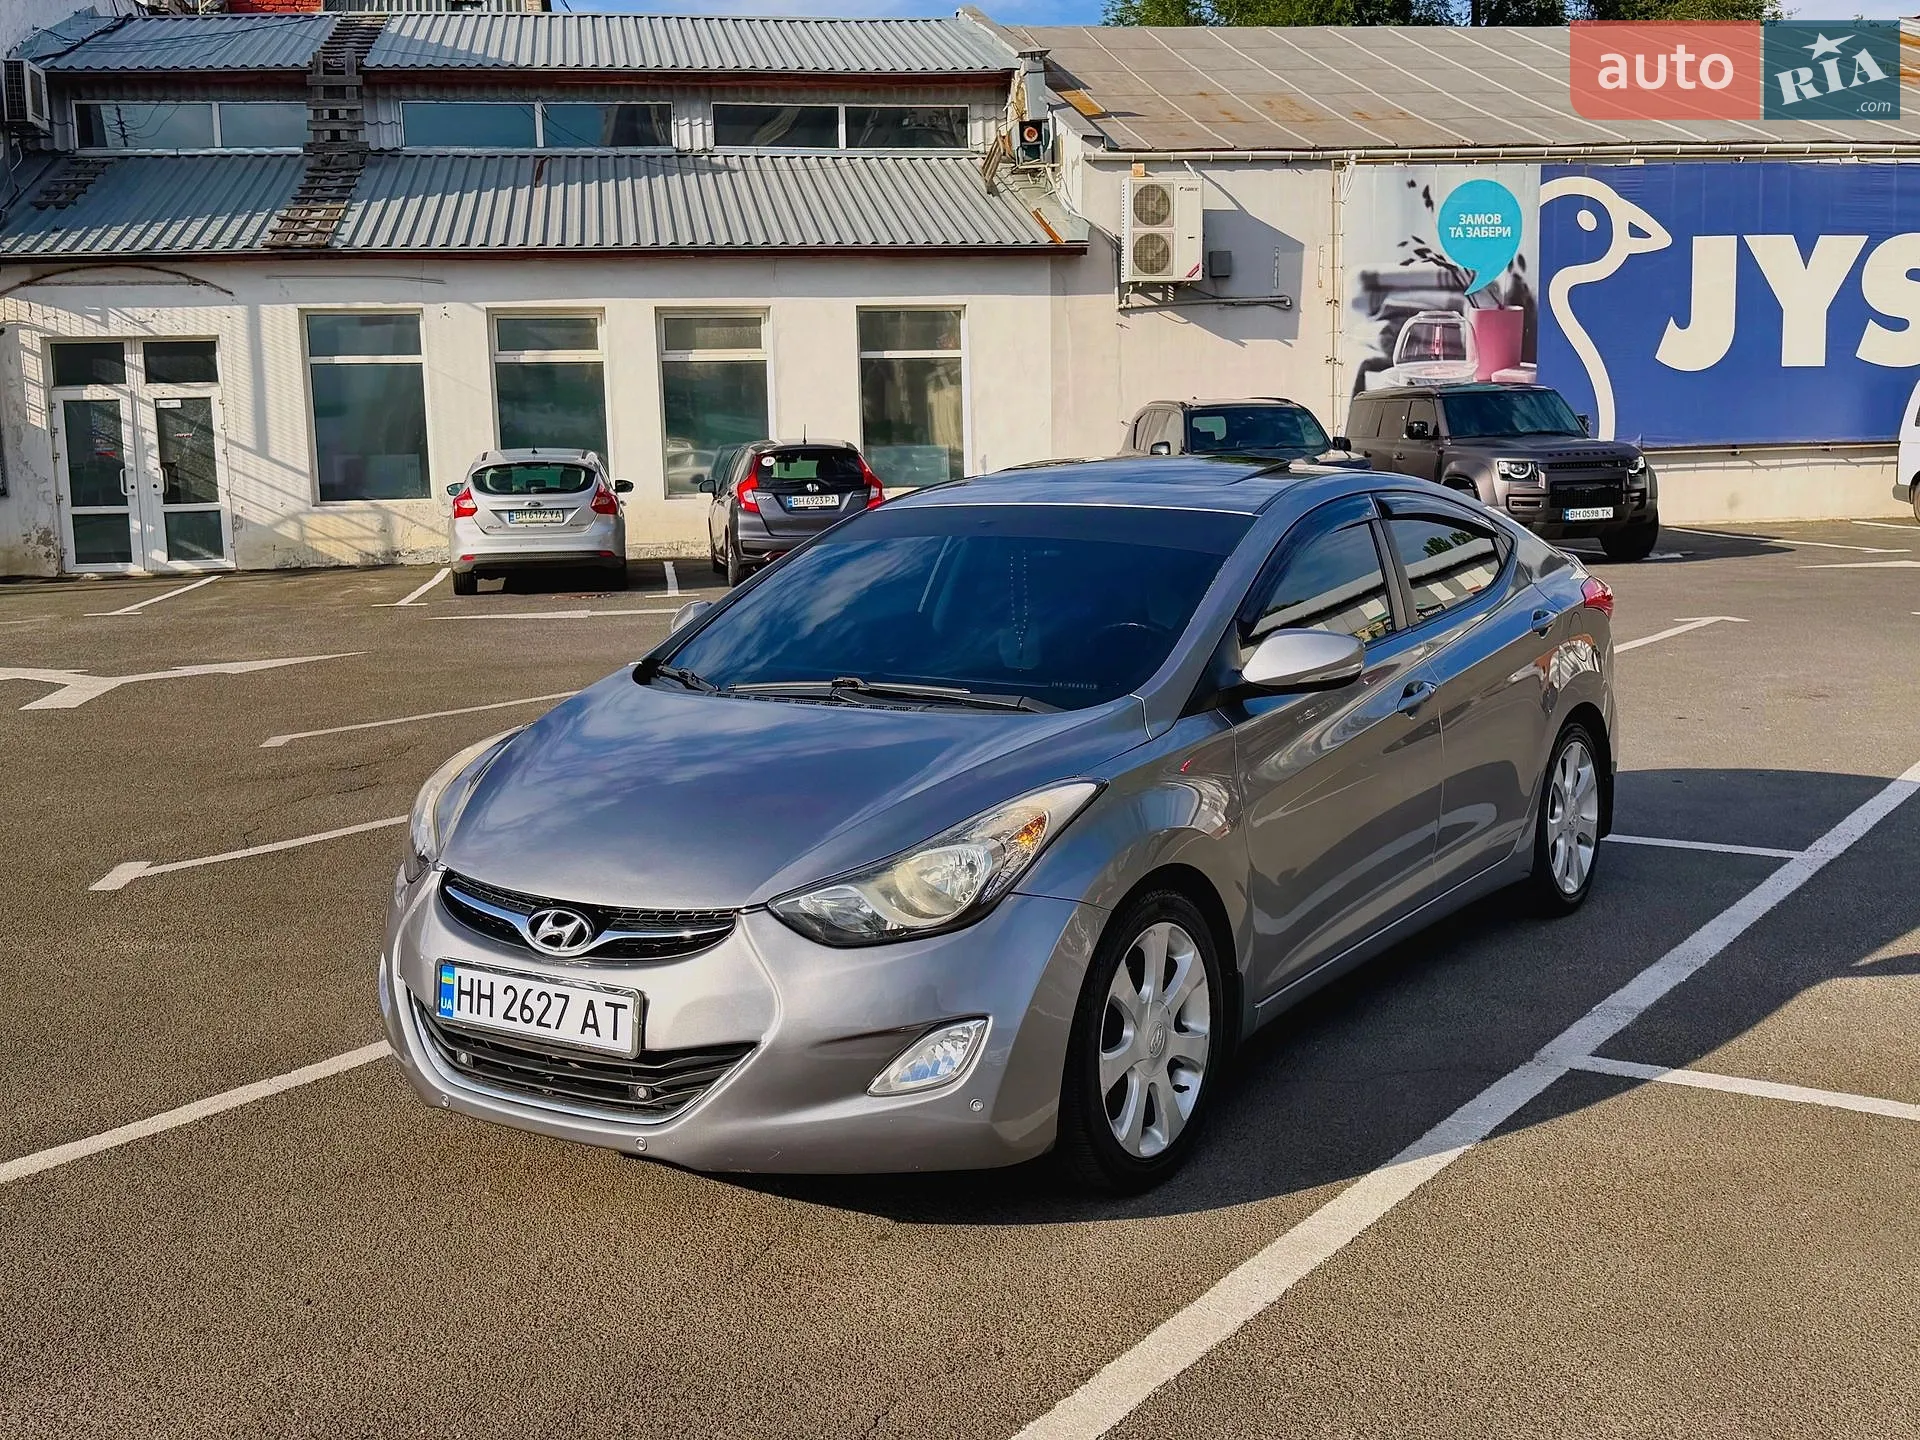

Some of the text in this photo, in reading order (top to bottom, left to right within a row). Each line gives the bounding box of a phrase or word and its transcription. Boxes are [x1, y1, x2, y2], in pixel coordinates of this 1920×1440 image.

[1459, 213, 1502, 225] ЗАМОВ
[1449, 226, 1511, 238] ТА ЗАБЕРИ
[806, 496, 824, 505] 6923
[825, 496, 837, 505] PA
[1570, 510, 1581, 519] BH
[1601, 508, 1611, 517] TK
[440, 998, 453, 1010] UA
[457, 975, 628, 1041] HH 2627 AT
